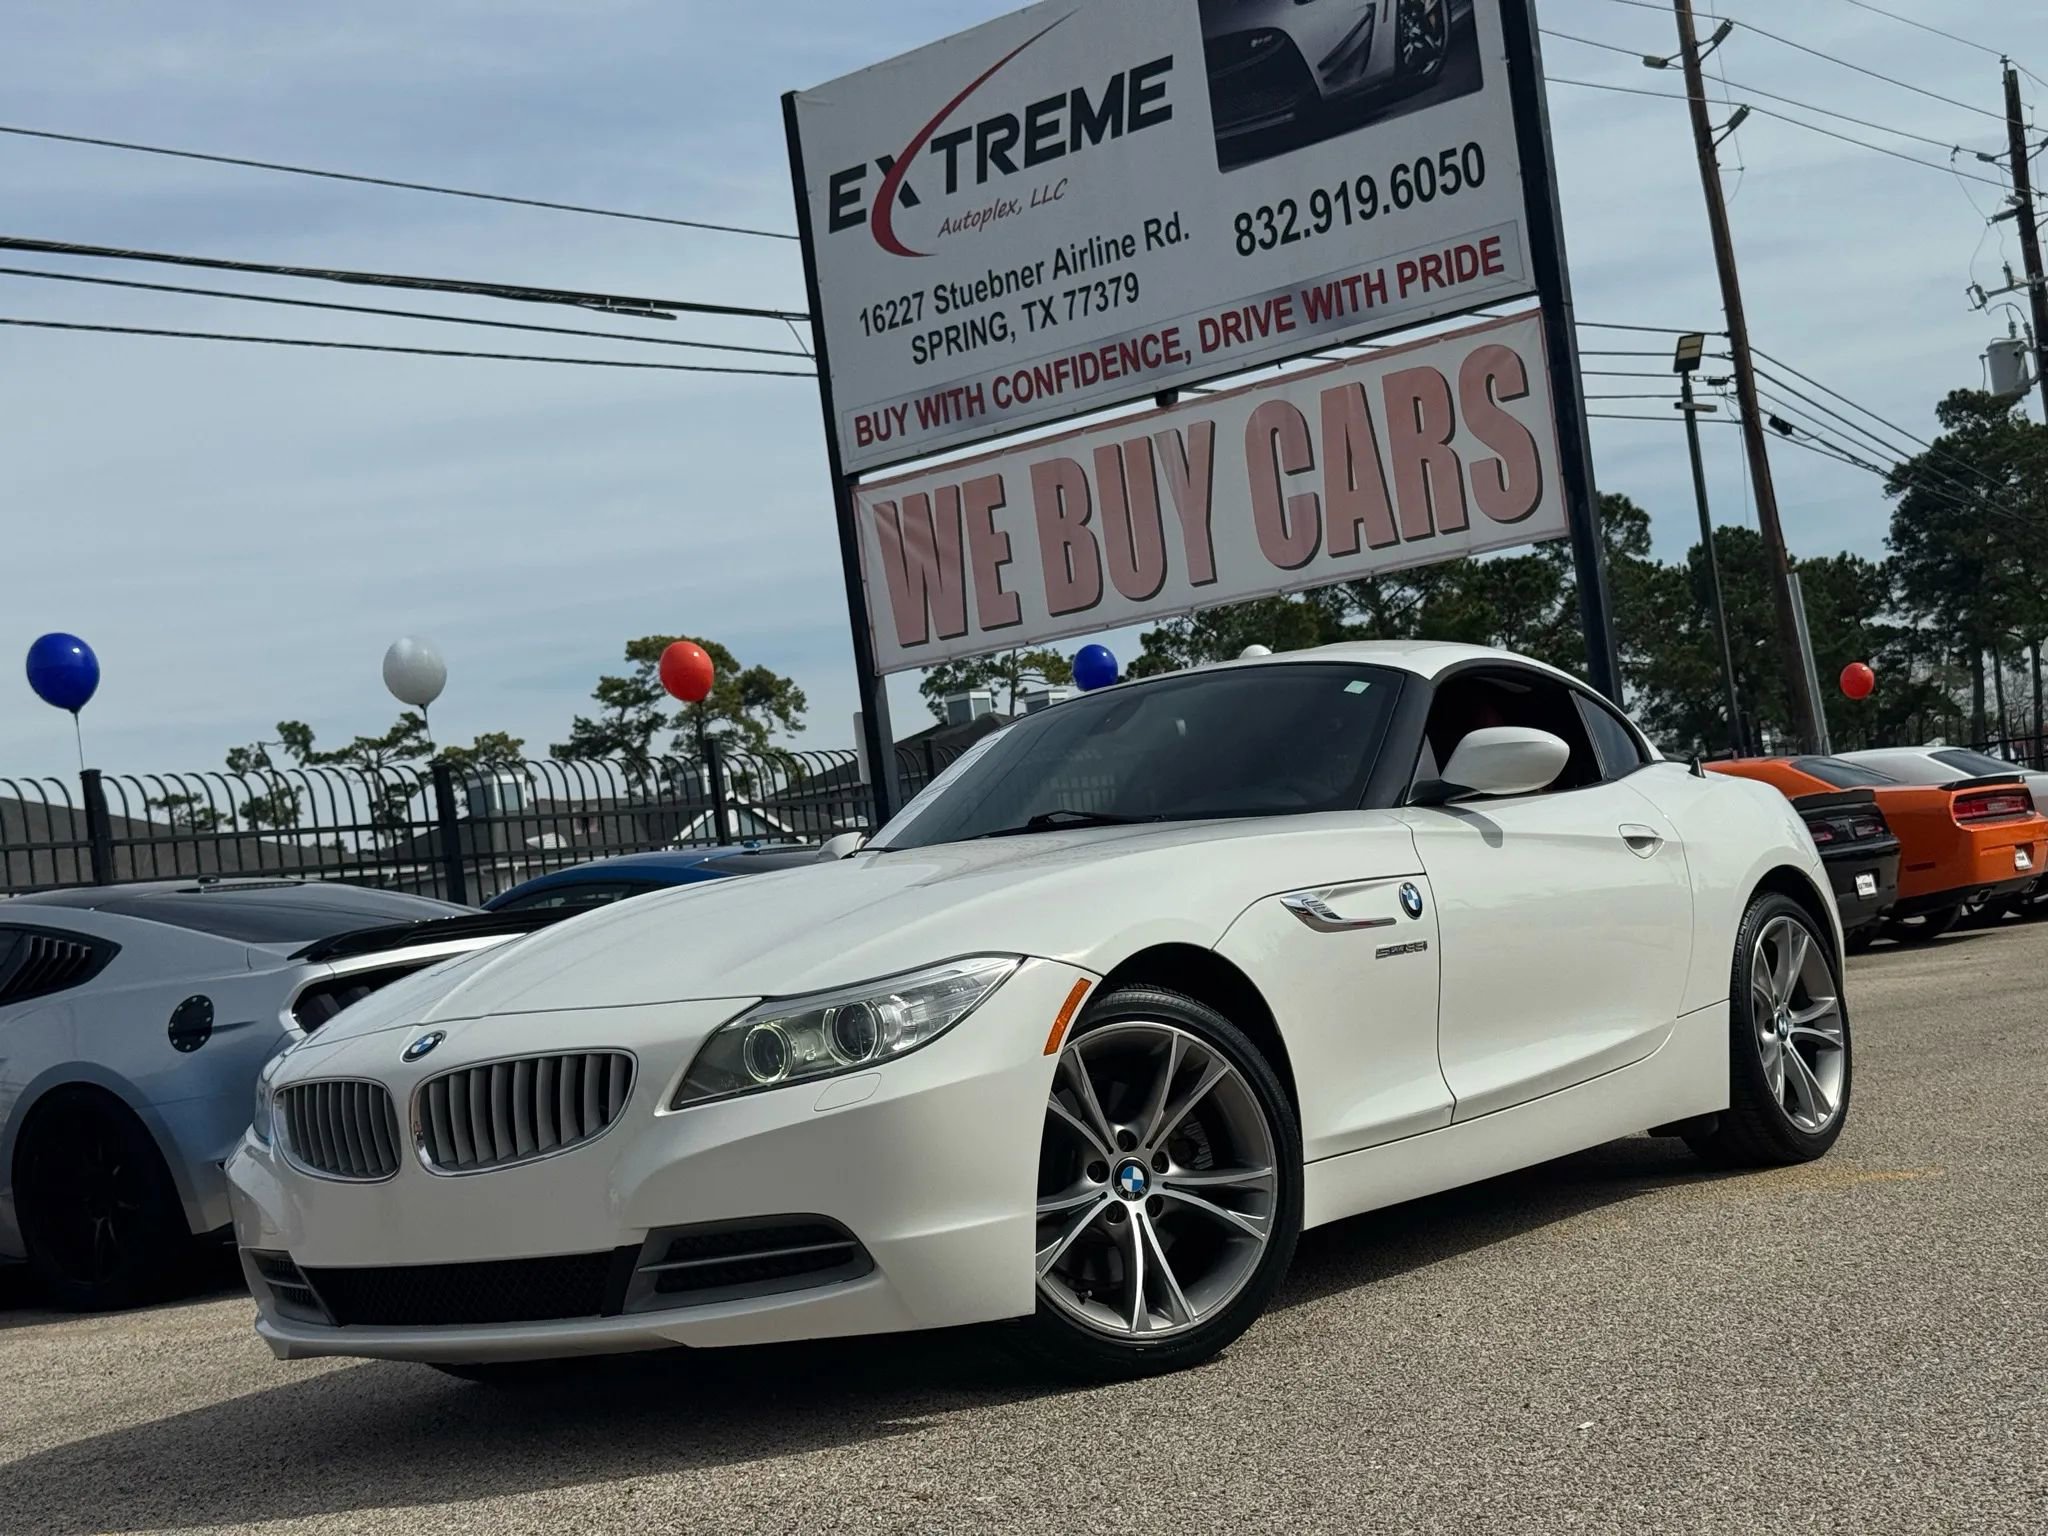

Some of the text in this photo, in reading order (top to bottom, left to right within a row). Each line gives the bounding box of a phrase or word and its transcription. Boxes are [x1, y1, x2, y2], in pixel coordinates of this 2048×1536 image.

[829, 54, 1174, 234] EXTREME
[1234, 142, 1485, 256] 832.919.6050
[937, 178, 1069, 238] Autoplex, LLC
[859, 211, 1190, 337] 16227 Stuebner Airline Rd.
[911, 272, 1140, 365] SPRING, TX 77379
[855, 235, 1505, 448] BUY WITH CONFIDENCE, DRIVE WITH PRIDE
[873, 344, 1543, 647] WE BUY CARS
